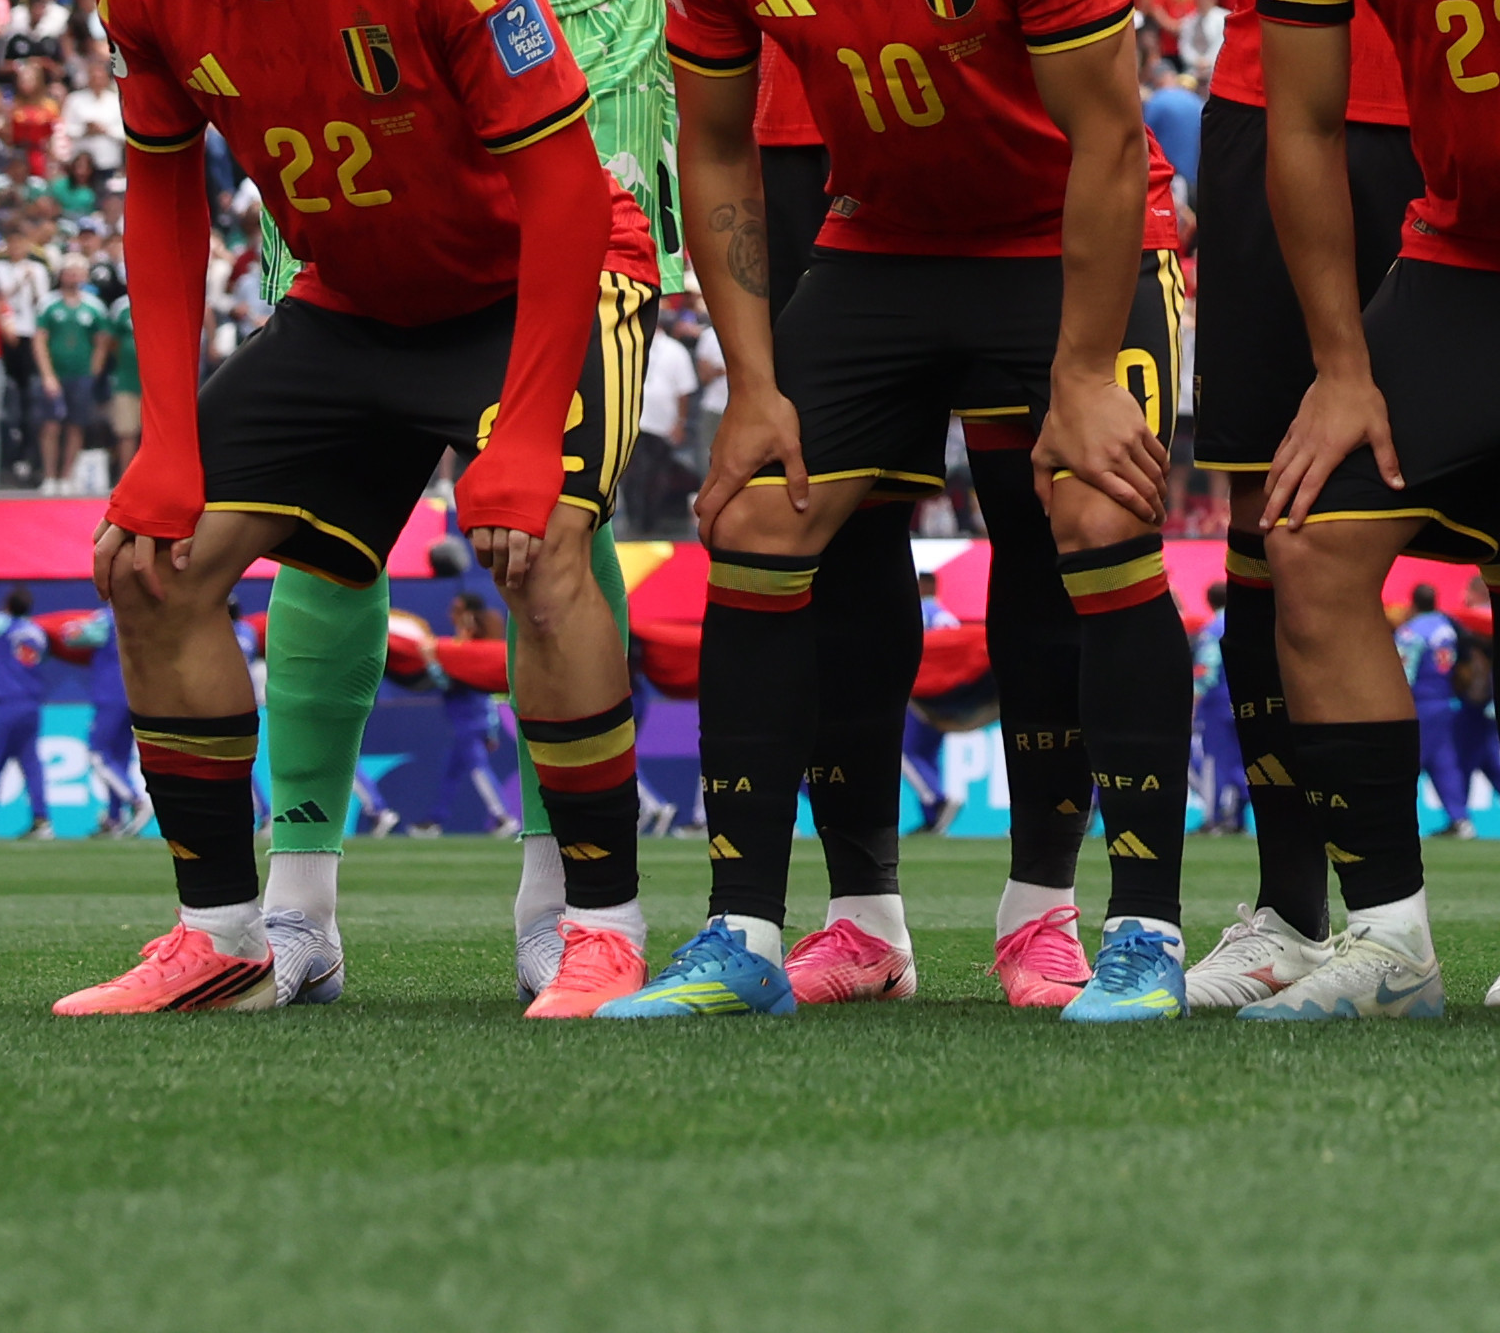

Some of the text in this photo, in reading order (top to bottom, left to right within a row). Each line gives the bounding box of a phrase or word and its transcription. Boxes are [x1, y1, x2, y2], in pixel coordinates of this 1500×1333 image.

[514, 31, 546, 57] PEACE
[836, 43, 946, 133] 10
[264, 121, 393, 214] 22
[1229, 697, 1284, 720] BF
